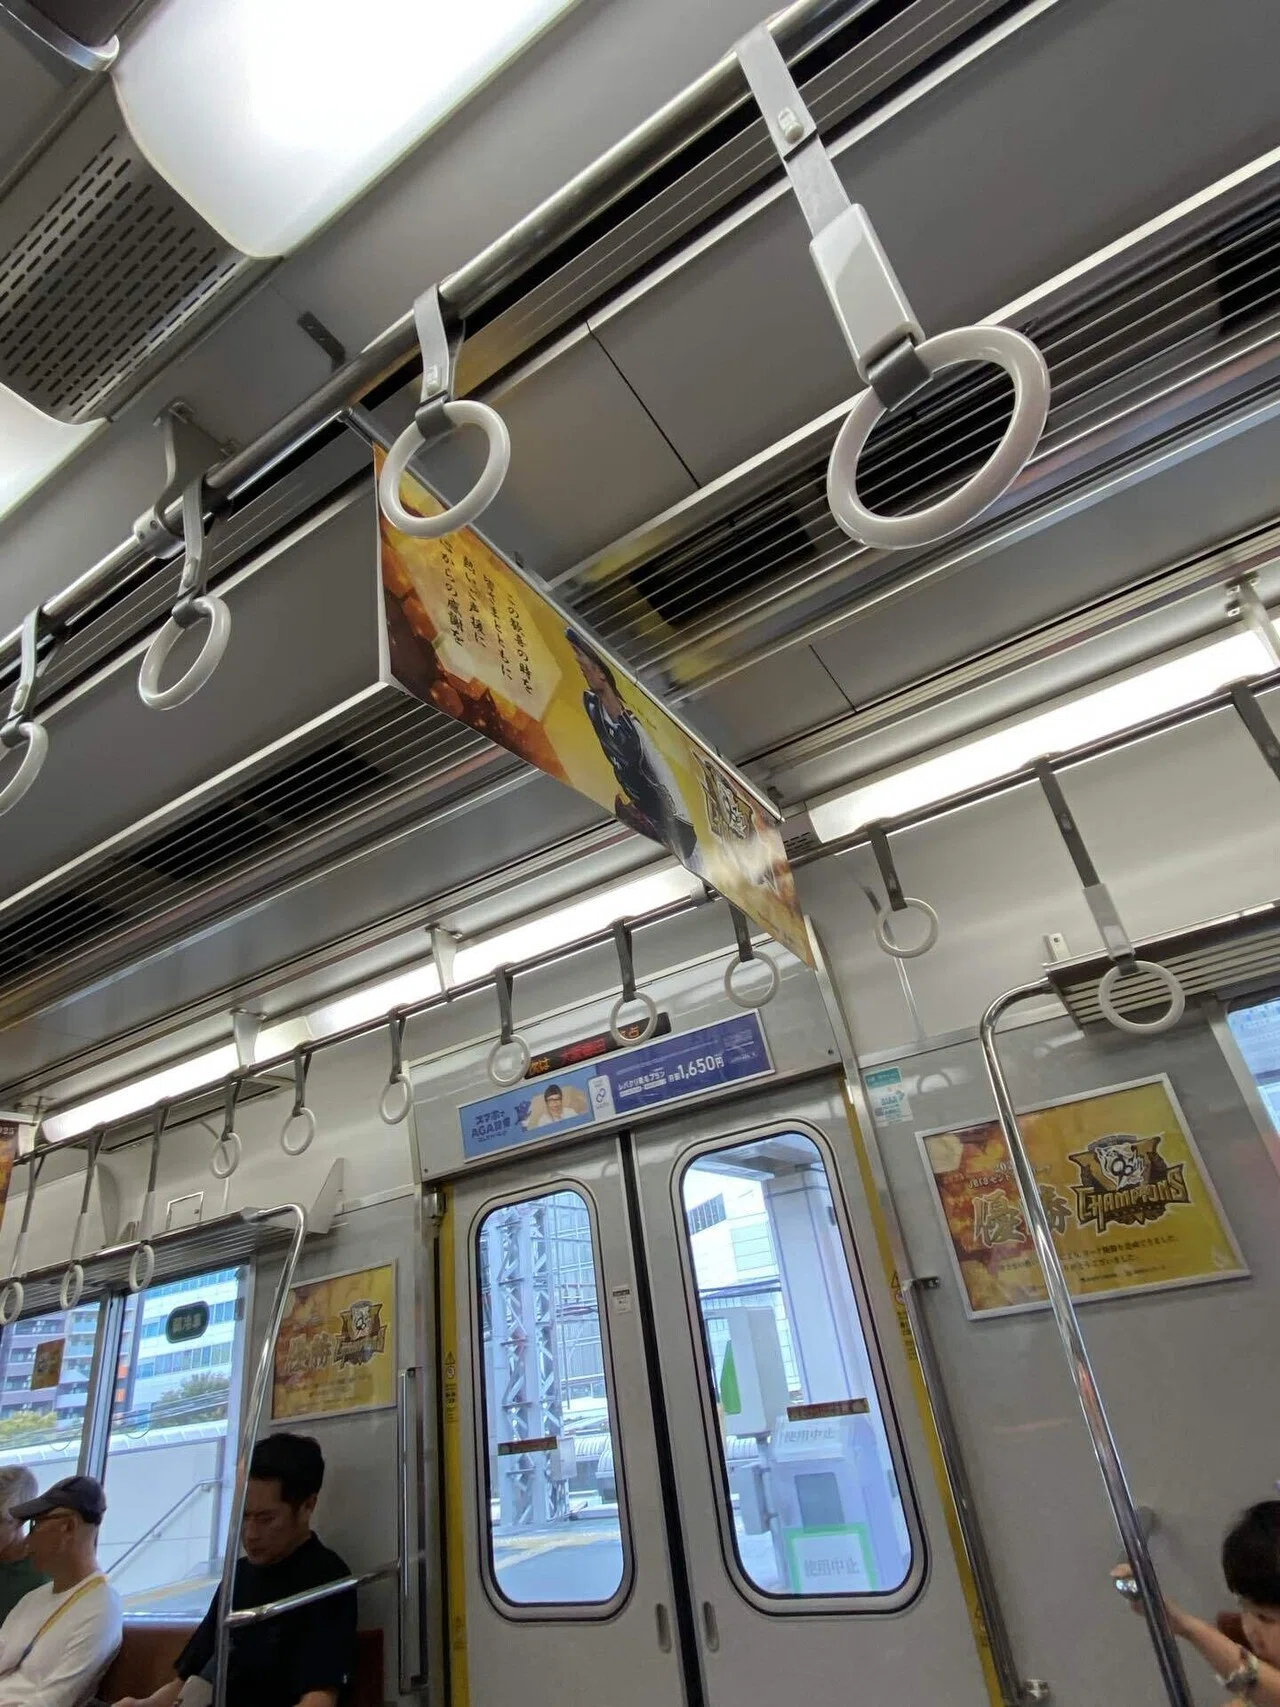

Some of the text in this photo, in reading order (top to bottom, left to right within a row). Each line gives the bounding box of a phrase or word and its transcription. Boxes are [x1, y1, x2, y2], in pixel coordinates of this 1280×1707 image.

[971, 1185, 1073, 1248] 優勝
[1073, 1165, 1190, 1231] CHAMPIONS
[804, 1558, 860, 1578] 使用中止
